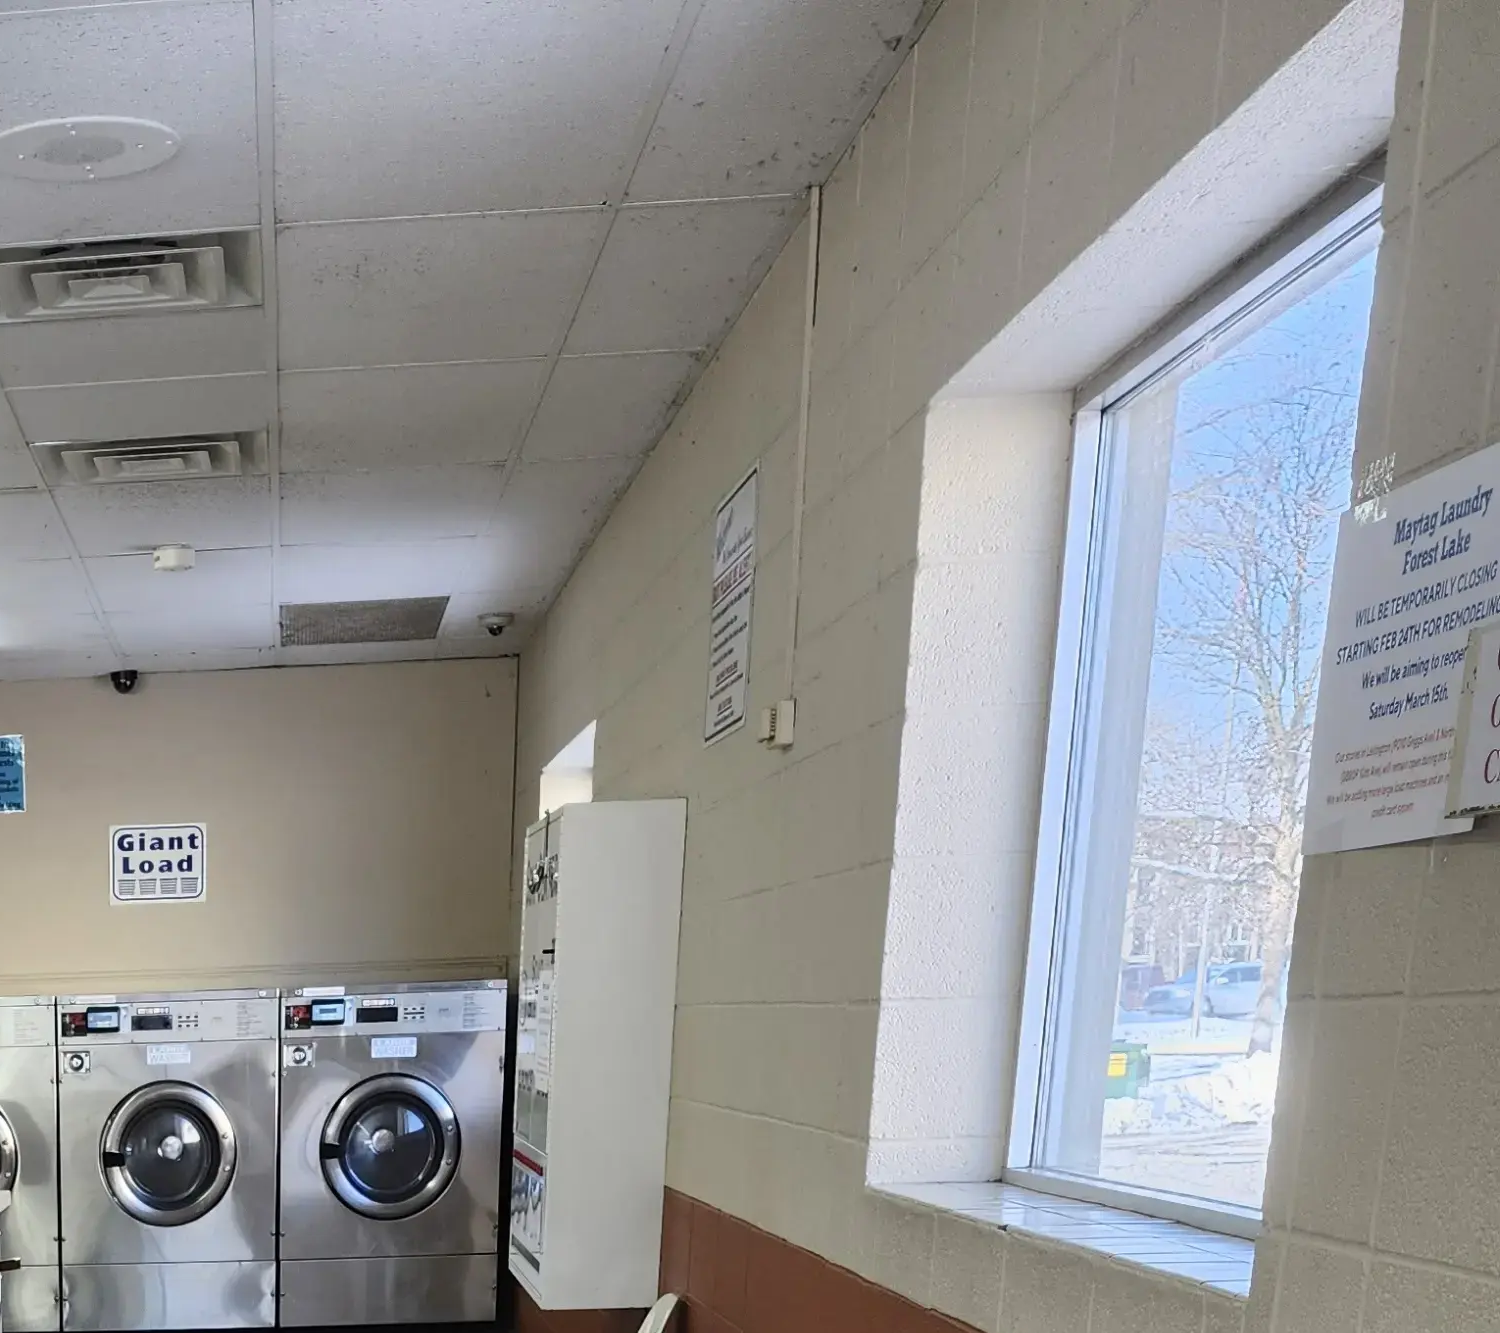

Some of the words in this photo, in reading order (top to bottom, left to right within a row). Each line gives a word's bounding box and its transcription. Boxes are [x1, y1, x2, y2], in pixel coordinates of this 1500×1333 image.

[1394, 518, 1437, 545] Maytag
[1440, 485, 1493, 527] Laundry
[1403, 541, 1438, 575] Forest
[1441, 529, 1471, 559] Lake
[1355, 603, 1375, 627] WILL
[1378, 600, 1390, 620] BE
[1392, 575, 1456, 617] TEMPORARILY
[1458, 560, 1498, 593] CLOSING
[1337, 640, 1379, 665] STARTING
[1380, 630, 1396, 652] FEB
[1398, 624, 1420, 649] 24TH
[1422, 616, 1442, 641] FOR
[1362, 670, 1374, 689] We
[1376, 666, 1389, 686] will
[1391, 661, 1400, 681] be
[1402, 656, 1429, 680] aiming
[1431, 653, 1439, 669] to
[1369, 699, 1403, 720] Saturday
[1407, 688, 1430, 711] March
[117, 833, 199, 851] Giant
[122, 855, 193, 874] Load
